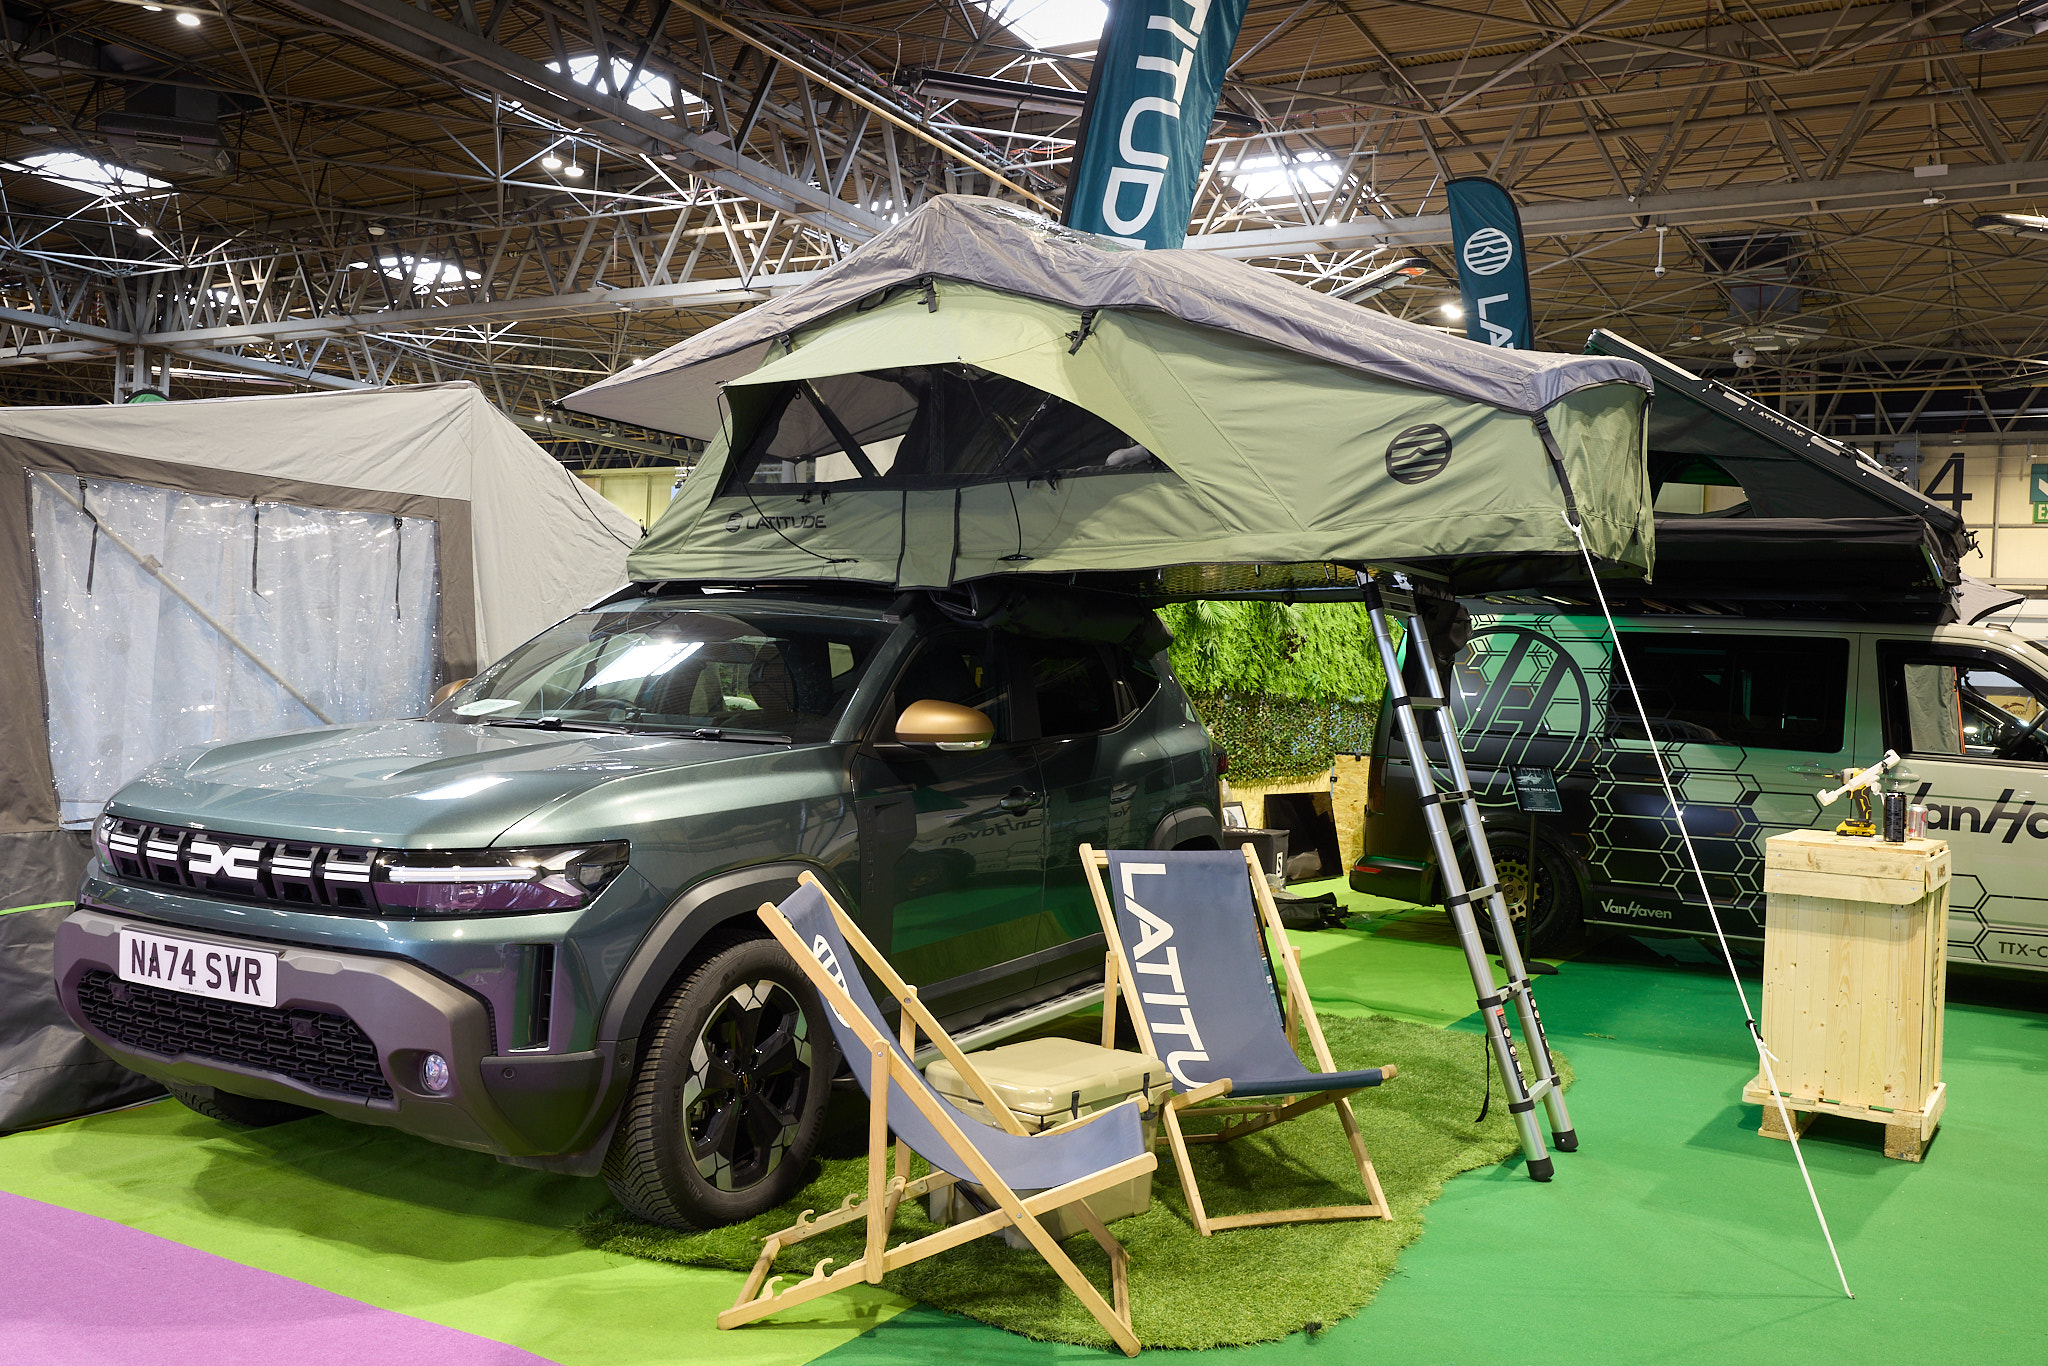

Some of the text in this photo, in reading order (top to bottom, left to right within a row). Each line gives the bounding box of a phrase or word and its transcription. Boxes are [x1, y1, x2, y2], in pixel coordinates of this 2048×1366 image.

[1477, 293, 1515, 349] LA
[1923, 452, 1972, 515] 4
[746, 514, 826, 530] LATITUDE
[1911, 782, 2048, 844] anHa
[1601, 899, 1672, 919] VanHaven
[131, 938, 262, 996] NA74 SVR
[1120, 863, 1210, 1093] LATITU
[1998, 941, 2048, 958] TTX-C
